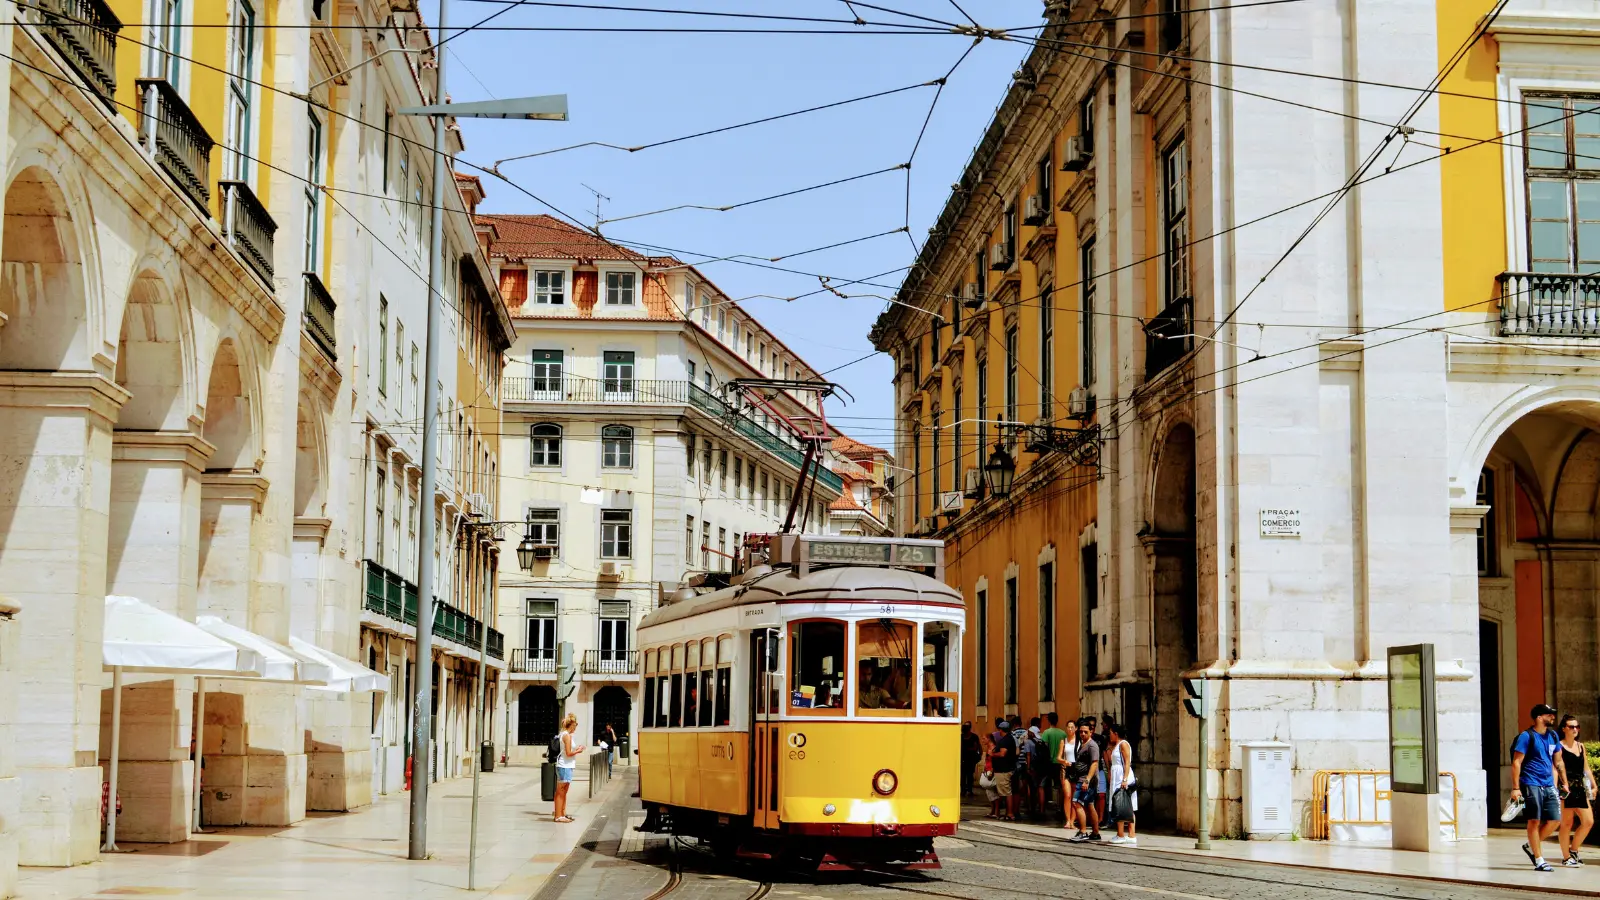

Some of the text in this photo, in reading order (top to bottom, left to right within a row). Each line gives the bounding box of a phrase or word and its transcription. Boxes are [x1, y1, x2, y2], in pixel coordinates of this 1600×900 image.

[1267, 509, 1294, 517] PRAÇA
[899, 546, 924, 562] 25
[879, 605, 895, 614] 581
